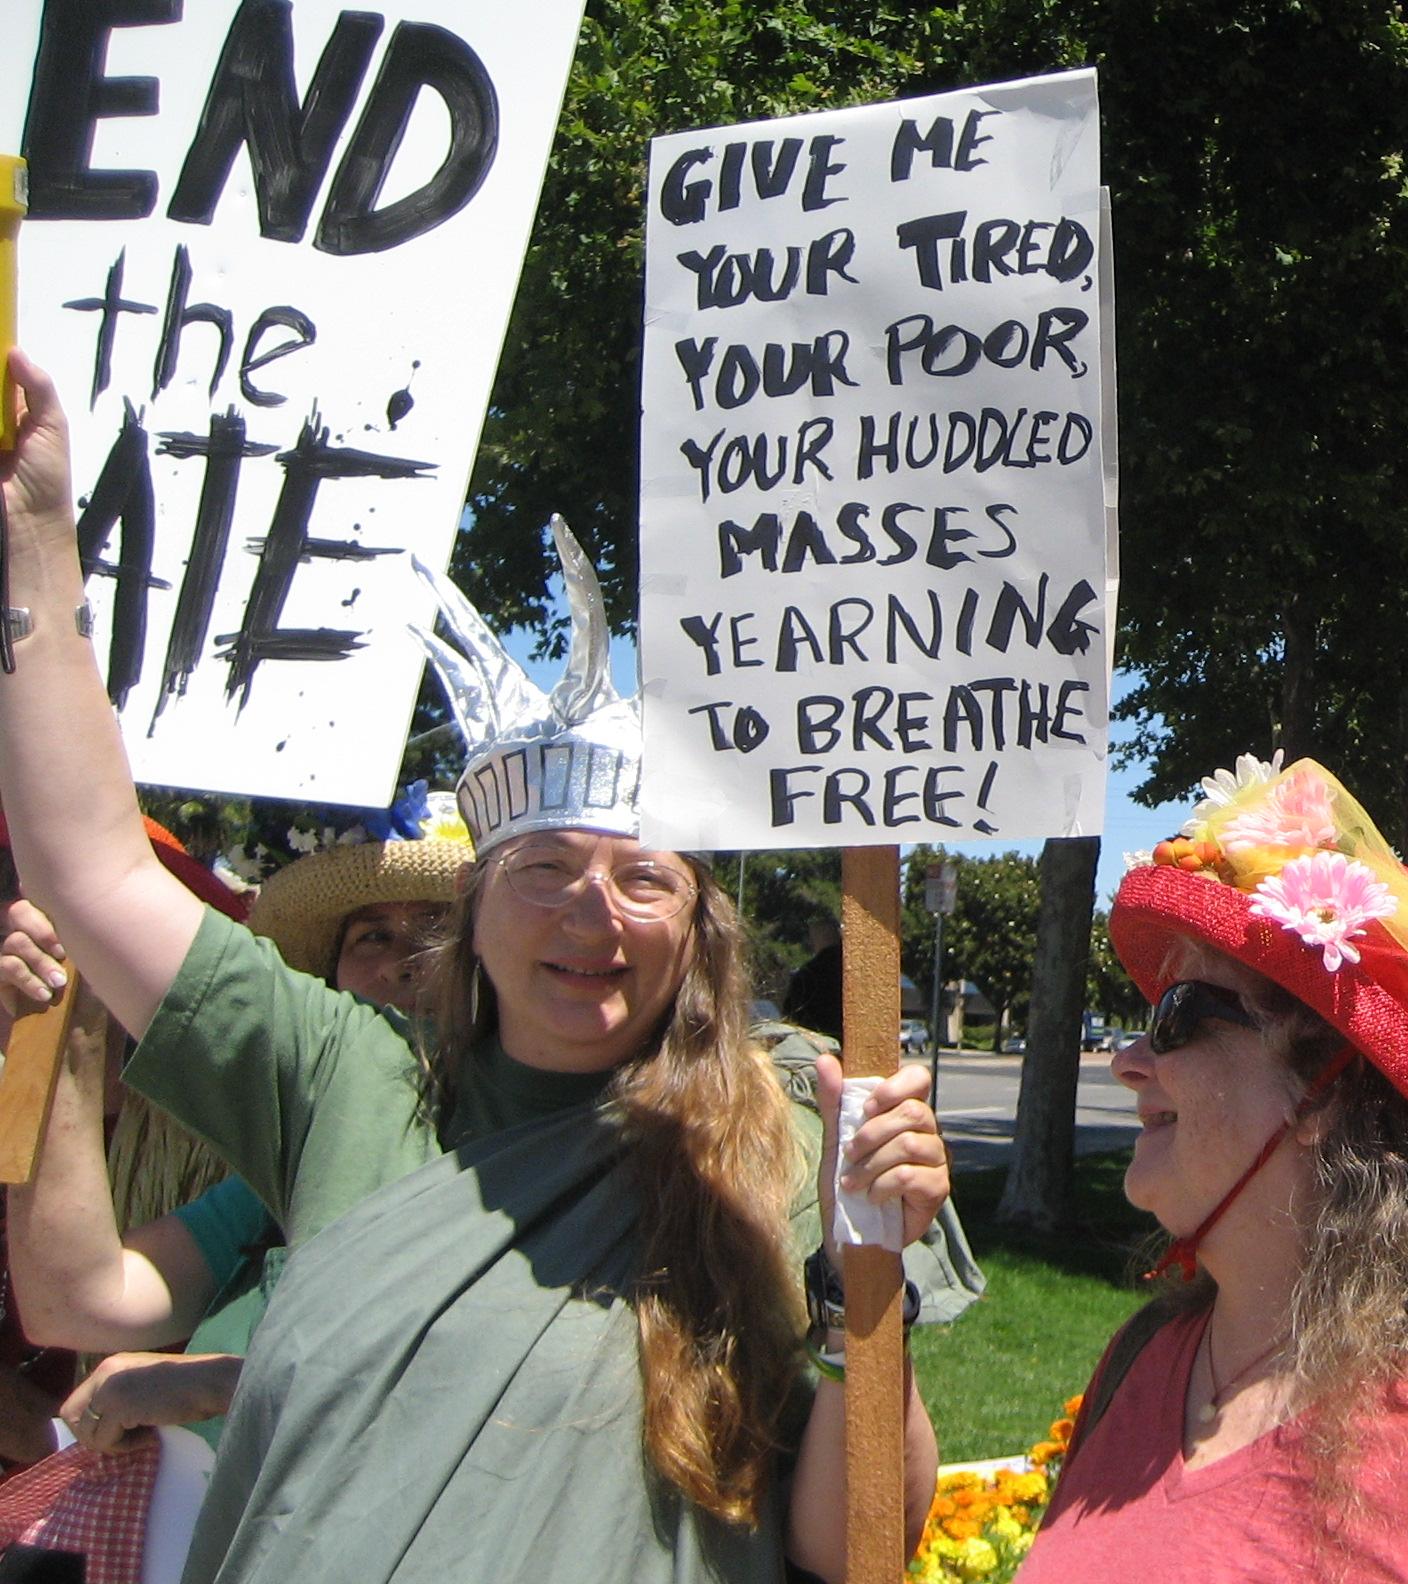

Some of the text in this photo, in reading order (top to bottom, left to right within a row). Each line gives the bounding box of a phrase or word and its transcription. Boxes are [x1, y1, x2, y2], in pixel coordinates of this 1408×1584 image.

[20, 0, 498, 256] END
[660, 108, 1003, 226] GIVE ME
[677, 210, 1095, 311] YOUR TIRED,
[62, 242, 317, 410] the
[675, 306, 1090, 411] YOUR POOR,
[680, 407, 1093, 503] YOUR HUDDLED
[74, 394, 440, 738] ATE
[718, 502, 1018, 580] MASSES
[680, 571, 1100, 677] YEARNING
[688, 677, 1091, 756] TO BREATHE
[770, 759, 998, 836] FREE!
